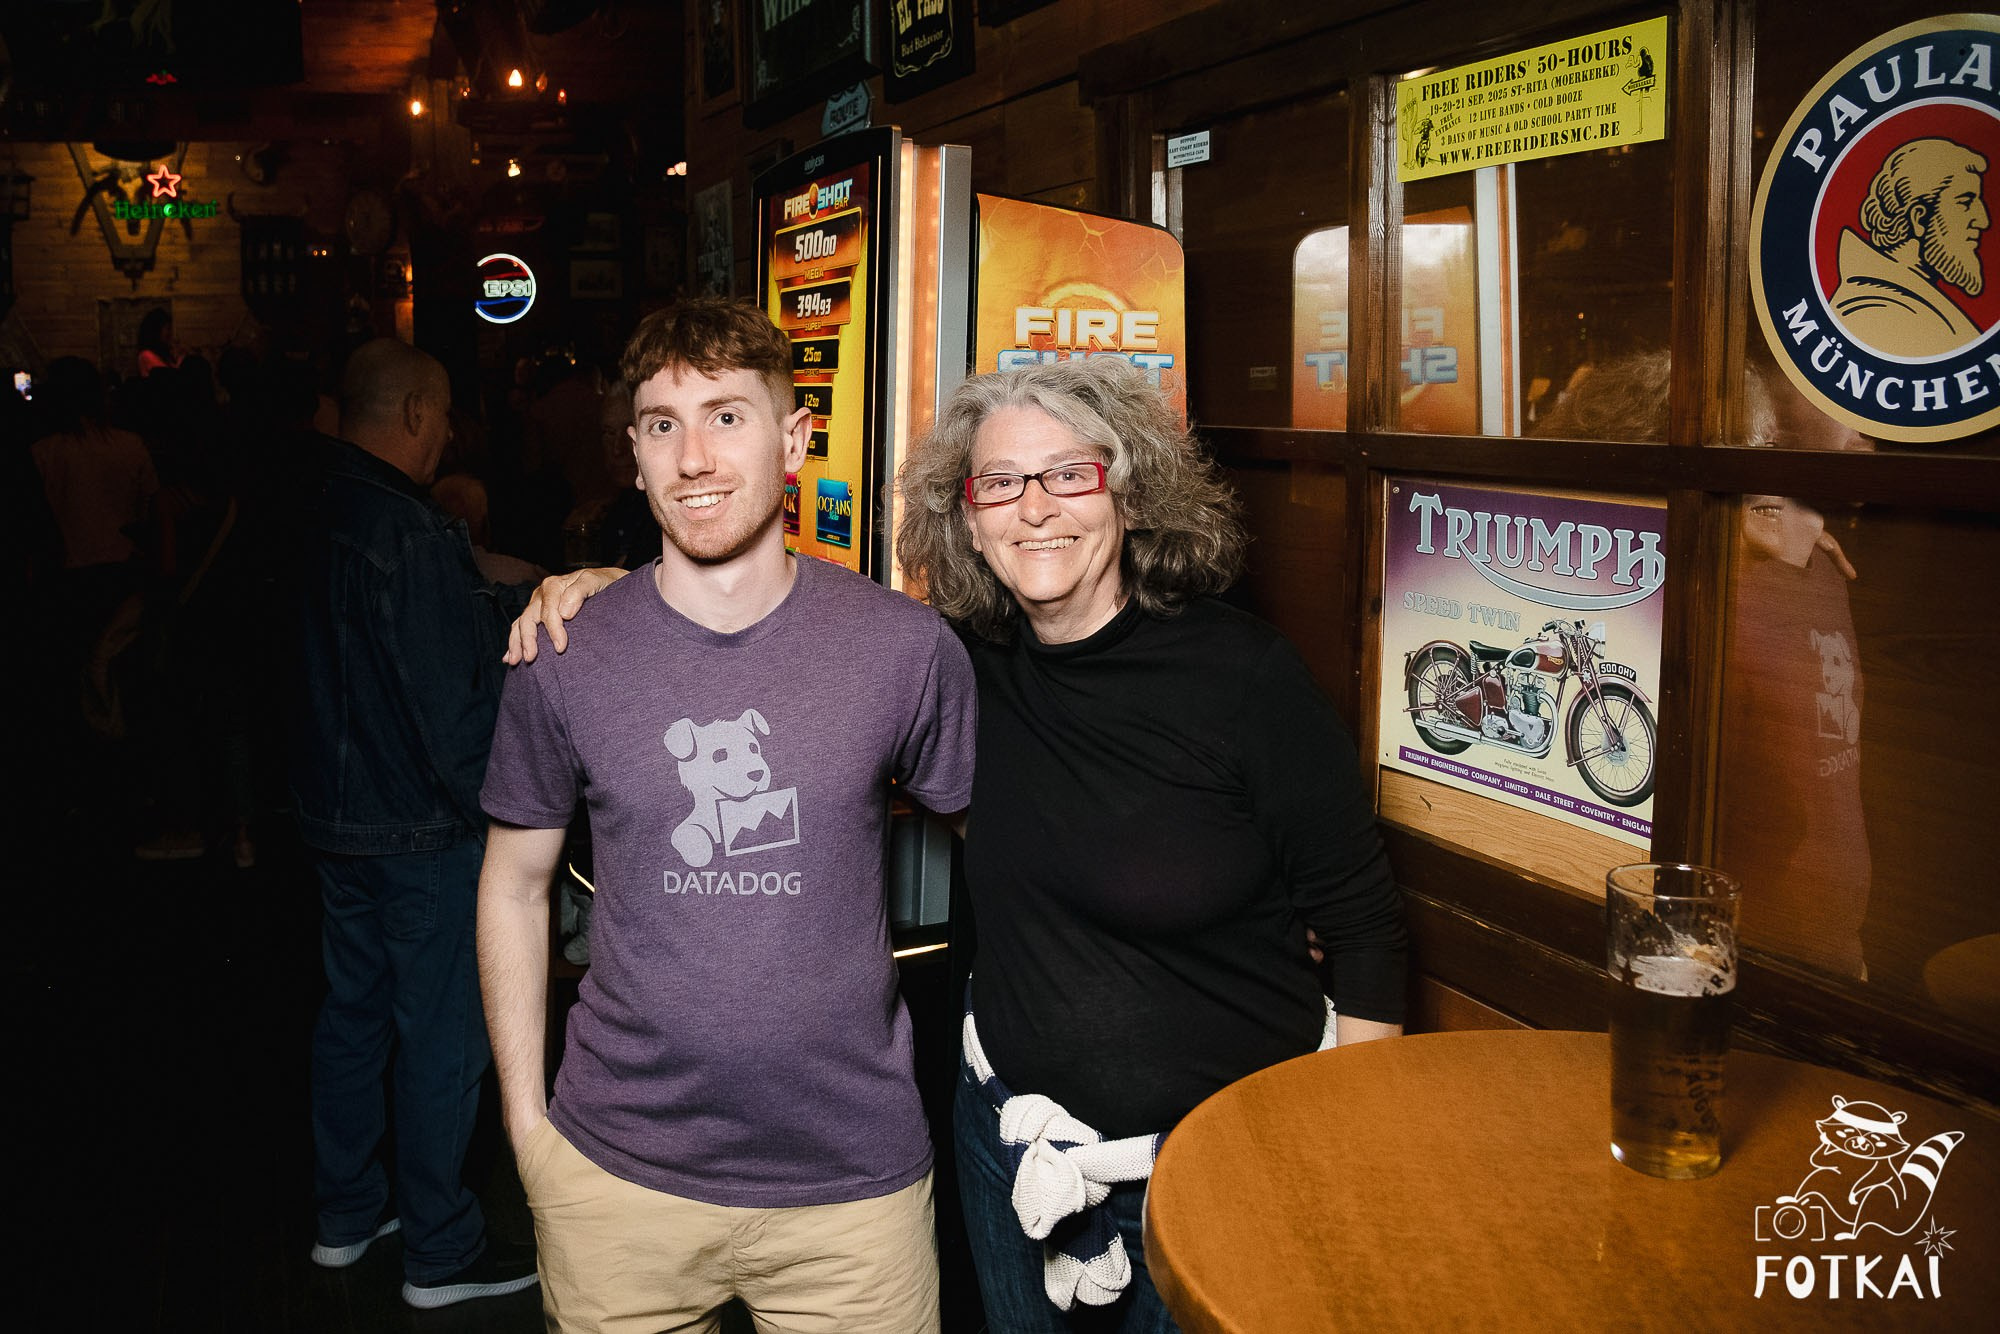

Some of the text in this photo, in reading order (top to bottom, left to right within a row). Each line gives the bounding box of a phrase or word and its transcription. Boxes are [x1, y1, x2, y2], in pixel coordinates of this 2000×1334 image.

[902, 30, 943, 57] Bad Behavior
[1422, 35, 1632, 101] FREE RIDERS' 50-HOURS
[1430, 63, 1620, 116] 19-20-21 SEP. 2025 ST-RITA (MOERKERKE)
[1440, 113, 1453, 125] FREE
[1469, 90, 1583, 123] 12 LIVE BANDS COLD BOOZE
[1792, 43, 2000, 174] PAULA
[1435, 115, 1461, 137] ENTRANCE
[1441, 103, 1617, 146] 3 DAYS OF MUSIC & OLD SCHOOL PARTY TIME
[1440, 121, 1620, 166] WWW.FREERIDERSMC.BE
[114, 200, 218, 219] Heineken
[784, 178, 853, 220] FIRE SHOT
[834, 197, 849, 210] BAR
[483, 280, 532, 297] EPSI
[804, 266, 824, 280] MEGA
[804, 322, 823, 333] SUPER
[1015, 306, 1159, 351] FIRE
[997, 350, 1175, 392] ST
[818, 496, 850, 517] OCEANS
[1409, 492, 1666, 594] TRIUMPH
[1403, 591, 1521, 632] SPEED TWIN
[1601, 664, 1635, 679] 500 OHV
[1405, 751, 1652, 834] TRIUMPH ENGINEERING COMPANY, LIMITED DALE STREET COVENTRY ENGLAN
[663, 870, 802, 896] DATADOG
